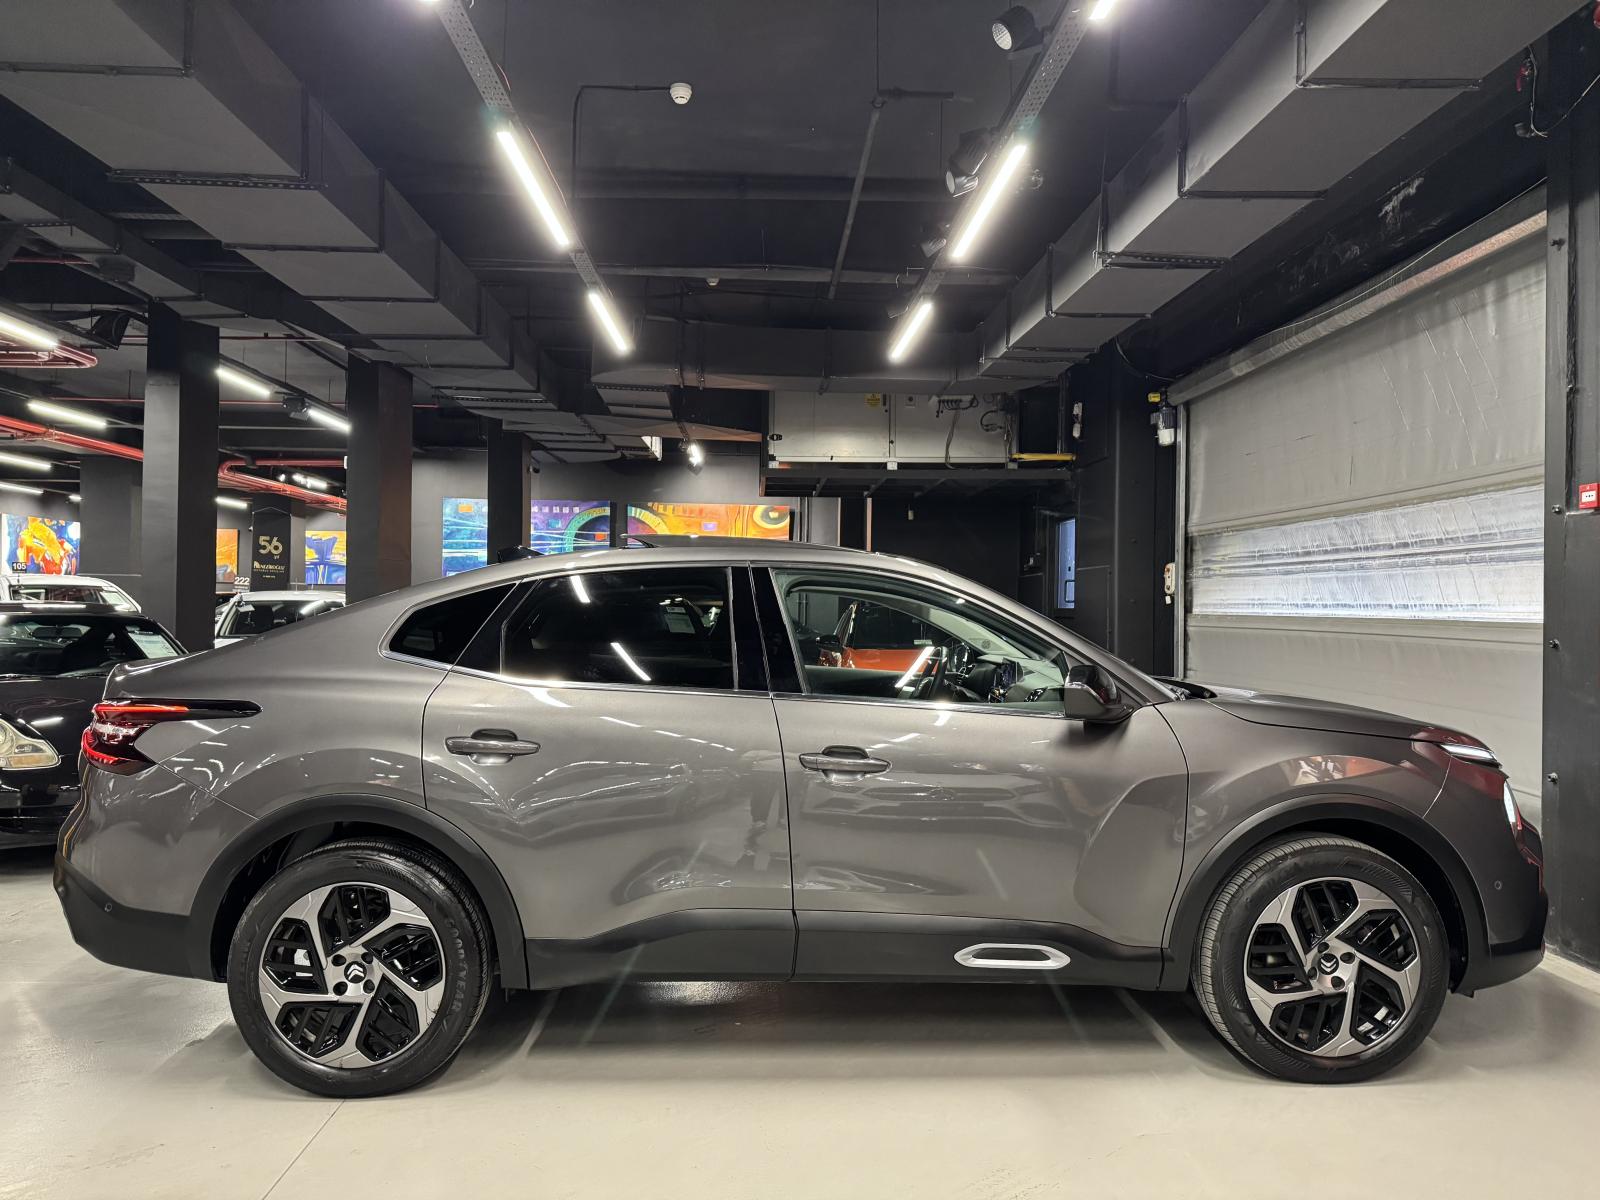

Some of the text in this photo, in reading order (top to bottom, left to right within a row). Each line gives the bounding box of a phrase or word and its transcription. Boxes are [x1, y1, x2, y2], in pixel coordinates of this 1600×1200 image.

[259, 536, 282, 554] 56
[12, 562, 26, 570] 105
[234, 577, 250, 585] 222
[445, 918, 467, 1012] GOODYEAR
